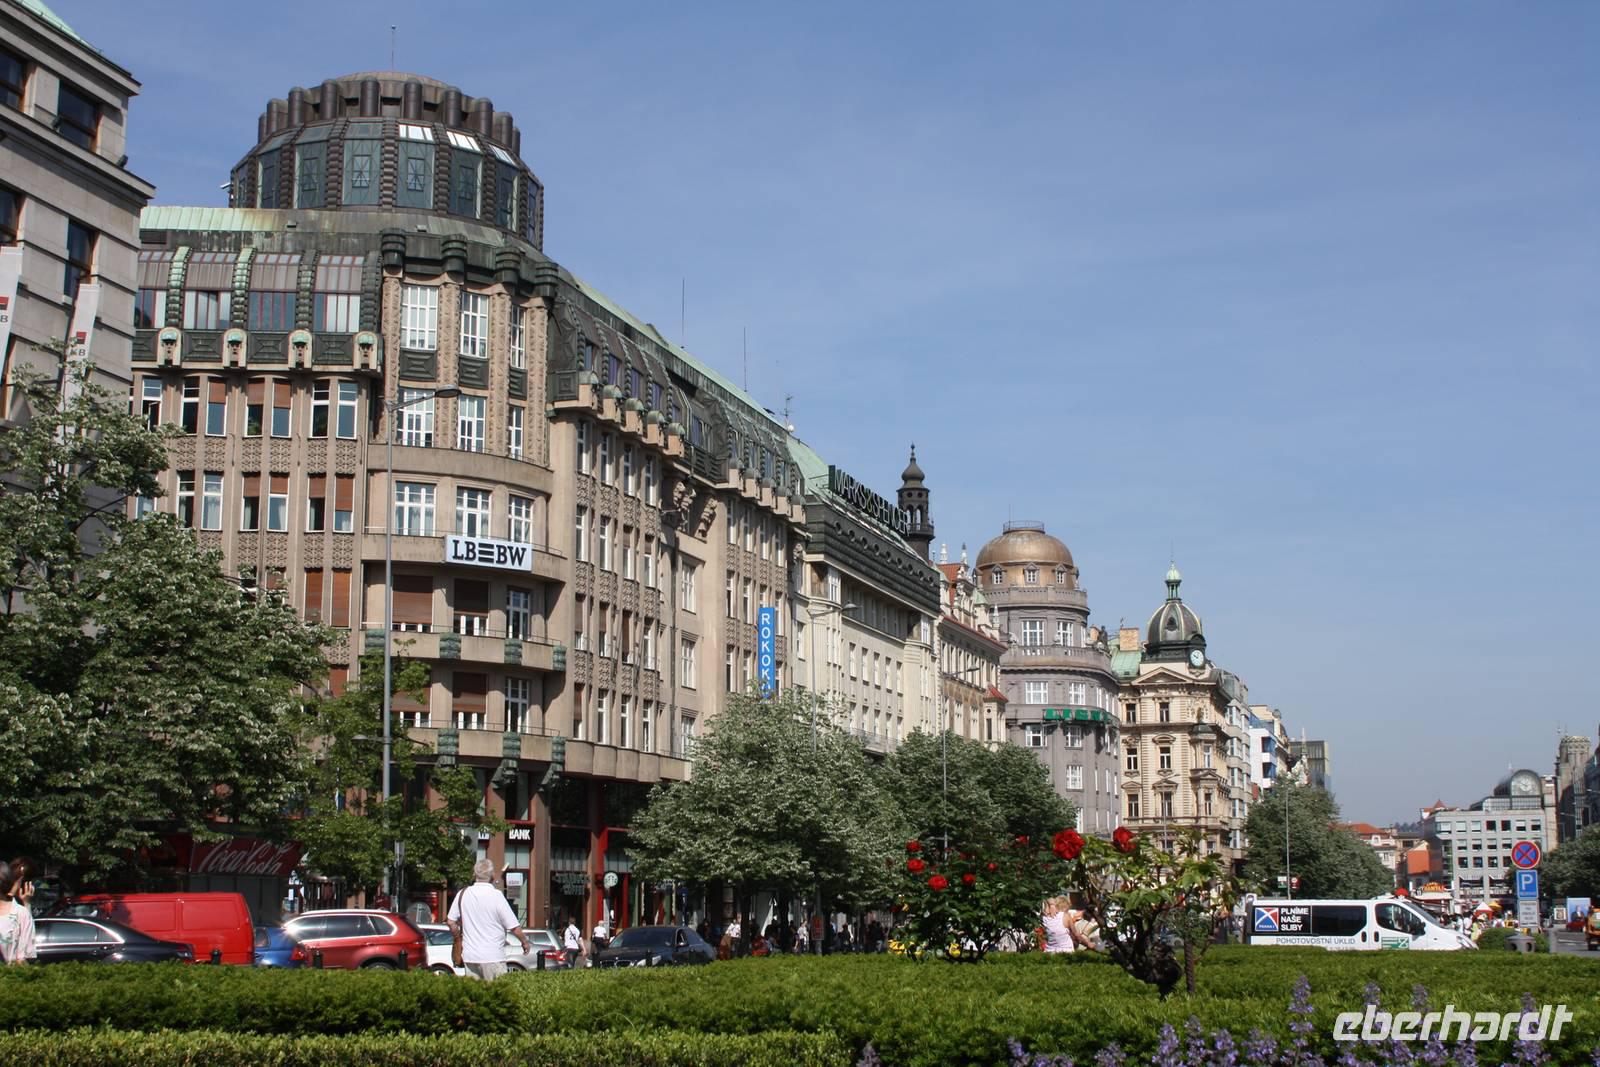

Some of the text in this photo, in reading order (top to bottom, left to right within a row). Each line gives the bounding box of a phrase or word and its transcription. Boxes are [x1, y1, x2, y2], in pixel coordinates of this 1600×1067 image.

[508, 829, 531, 840] BANK
[1521, 873, 1534, 890] P
[1280, 907, 1309, 915] PLNÍME
[1280, 915, 1302, 923] NAŠE
